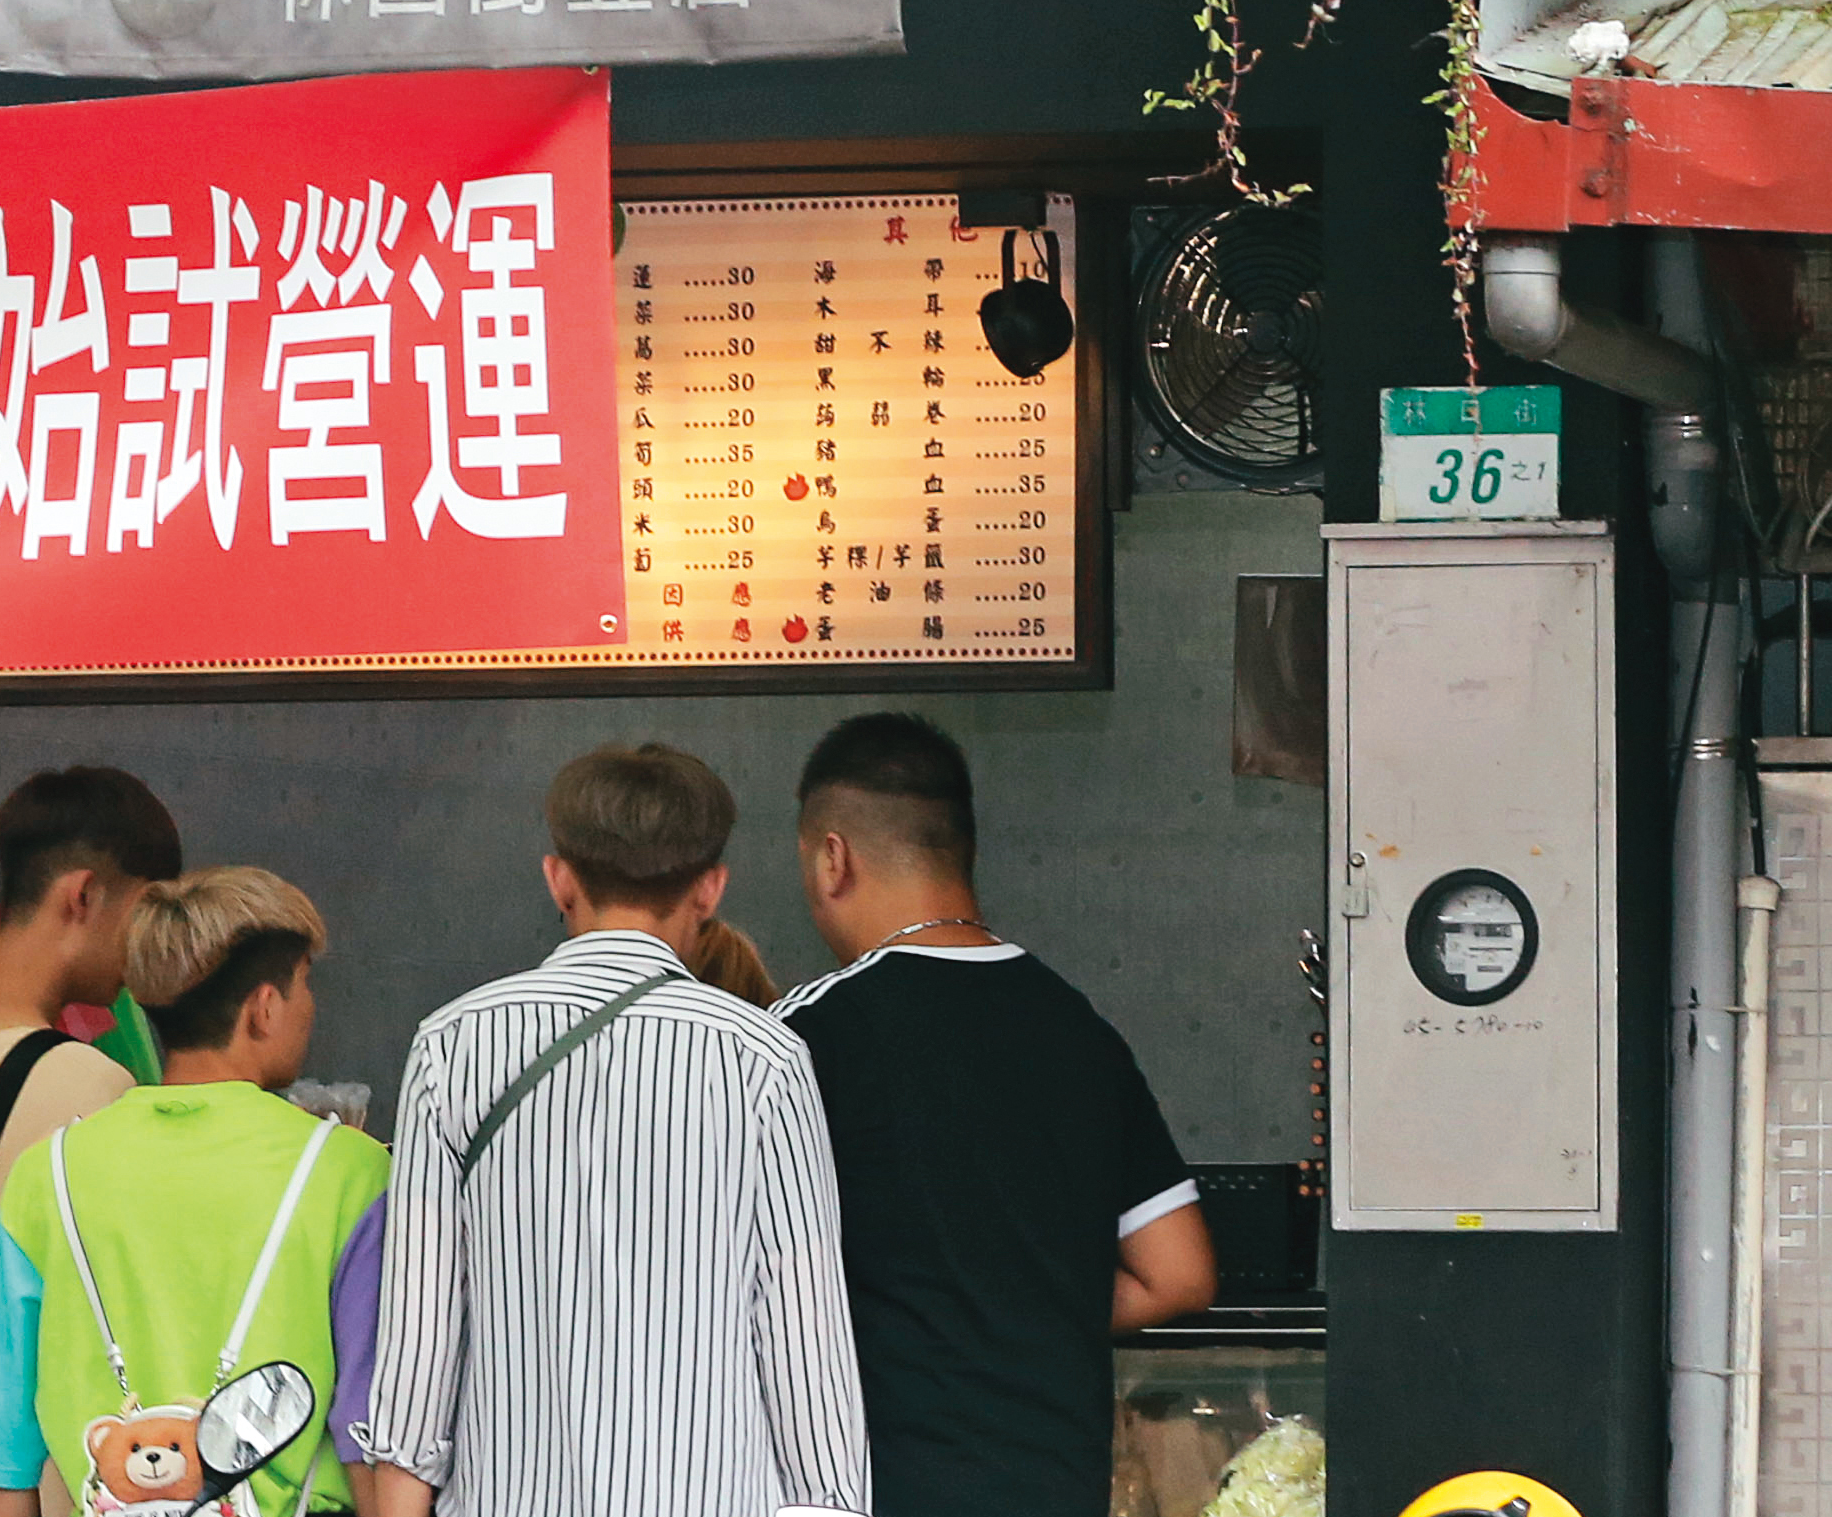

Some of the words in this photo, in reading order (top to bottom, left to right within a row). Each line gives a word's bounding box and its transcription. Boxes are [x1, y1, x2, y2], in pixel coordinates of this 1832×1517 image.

[728, 266, 754, 285] 30
[728, 302, 754, 321] 30
[814, 293, 944, 320] 木耳
[728, 337, 754, 356] 30
[728, 373, 754, 392] 30
[728, 409, 754, 427] 20
[1403, 396, 1537, 427] 林口街
[728, 444, 754, 463] 35
[1019, 439, 1046, 458] 25
[1429, 449, 1504, 504] 36
[728, 480, 754, 498] 20
[728, 515, 754, 534] 30
[1019, 510, 1046, 530] 20
[728, 550, 754, 570] 25
[1019, 546, 1046, 565] 30
[1019, 583, 1046, 601] 20
[1019, 618, 1046, 636] 25
